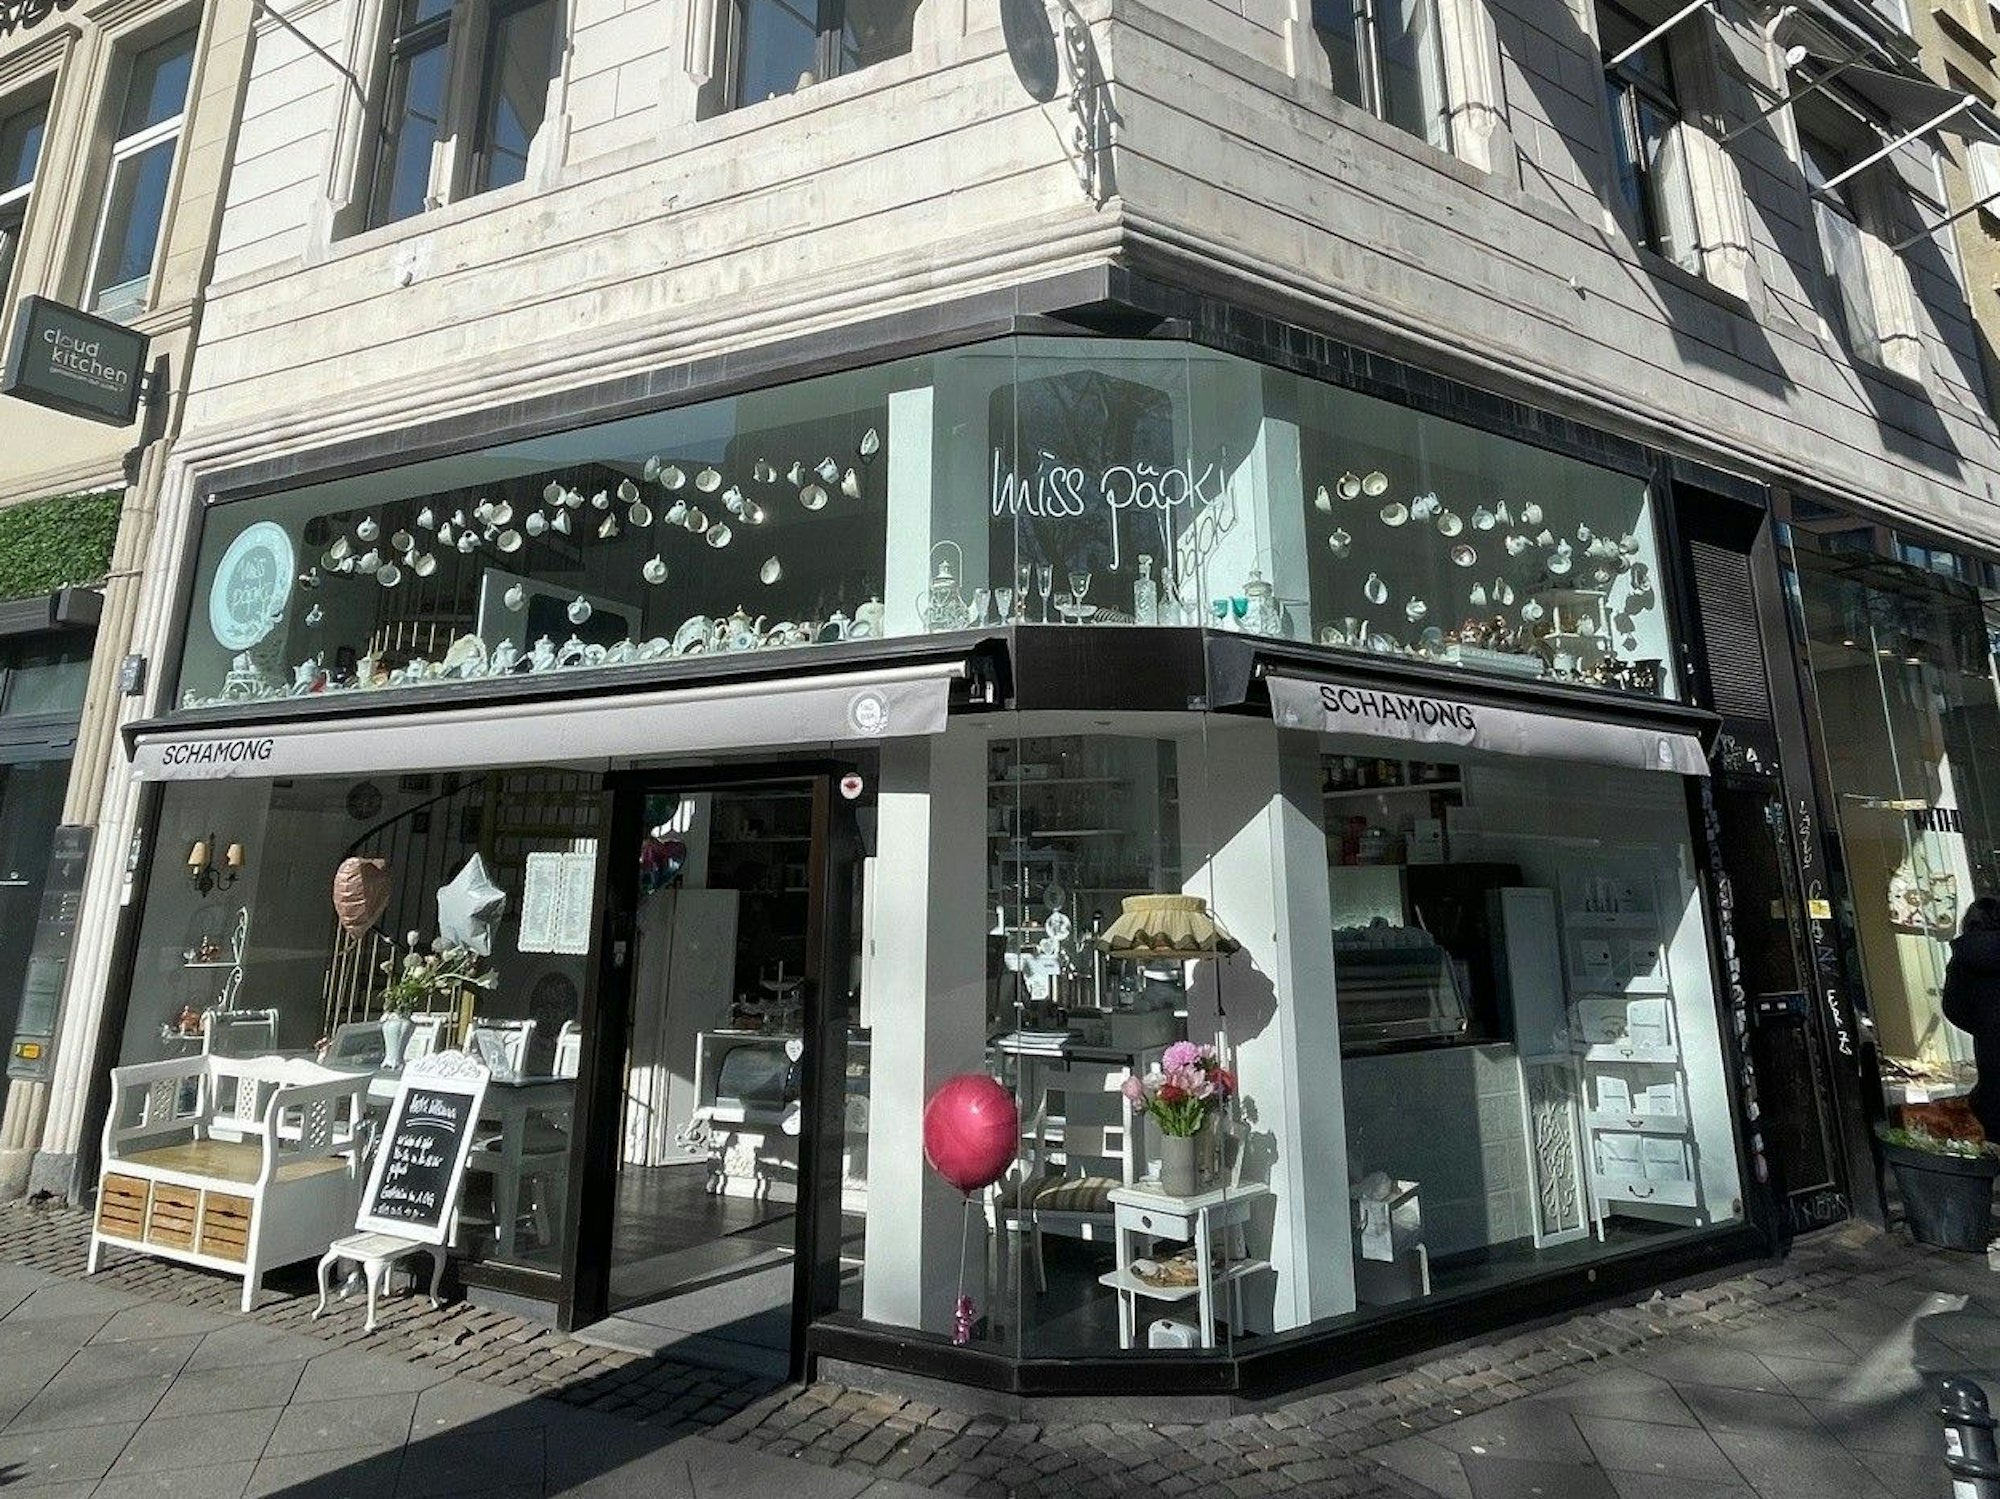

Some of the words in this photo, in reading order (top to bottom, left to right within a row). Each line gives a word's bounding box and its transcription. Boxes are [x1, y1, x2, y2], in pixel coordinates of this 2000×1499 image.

[43, 328, 100, 358] cloud
[51, 346, 128, 385] kitchen
[992, 447, 1086, 518] miss
[1319, 686, 1477, 730] SCHAMONG
[162, 739, 274, 765] SCHAMONG
